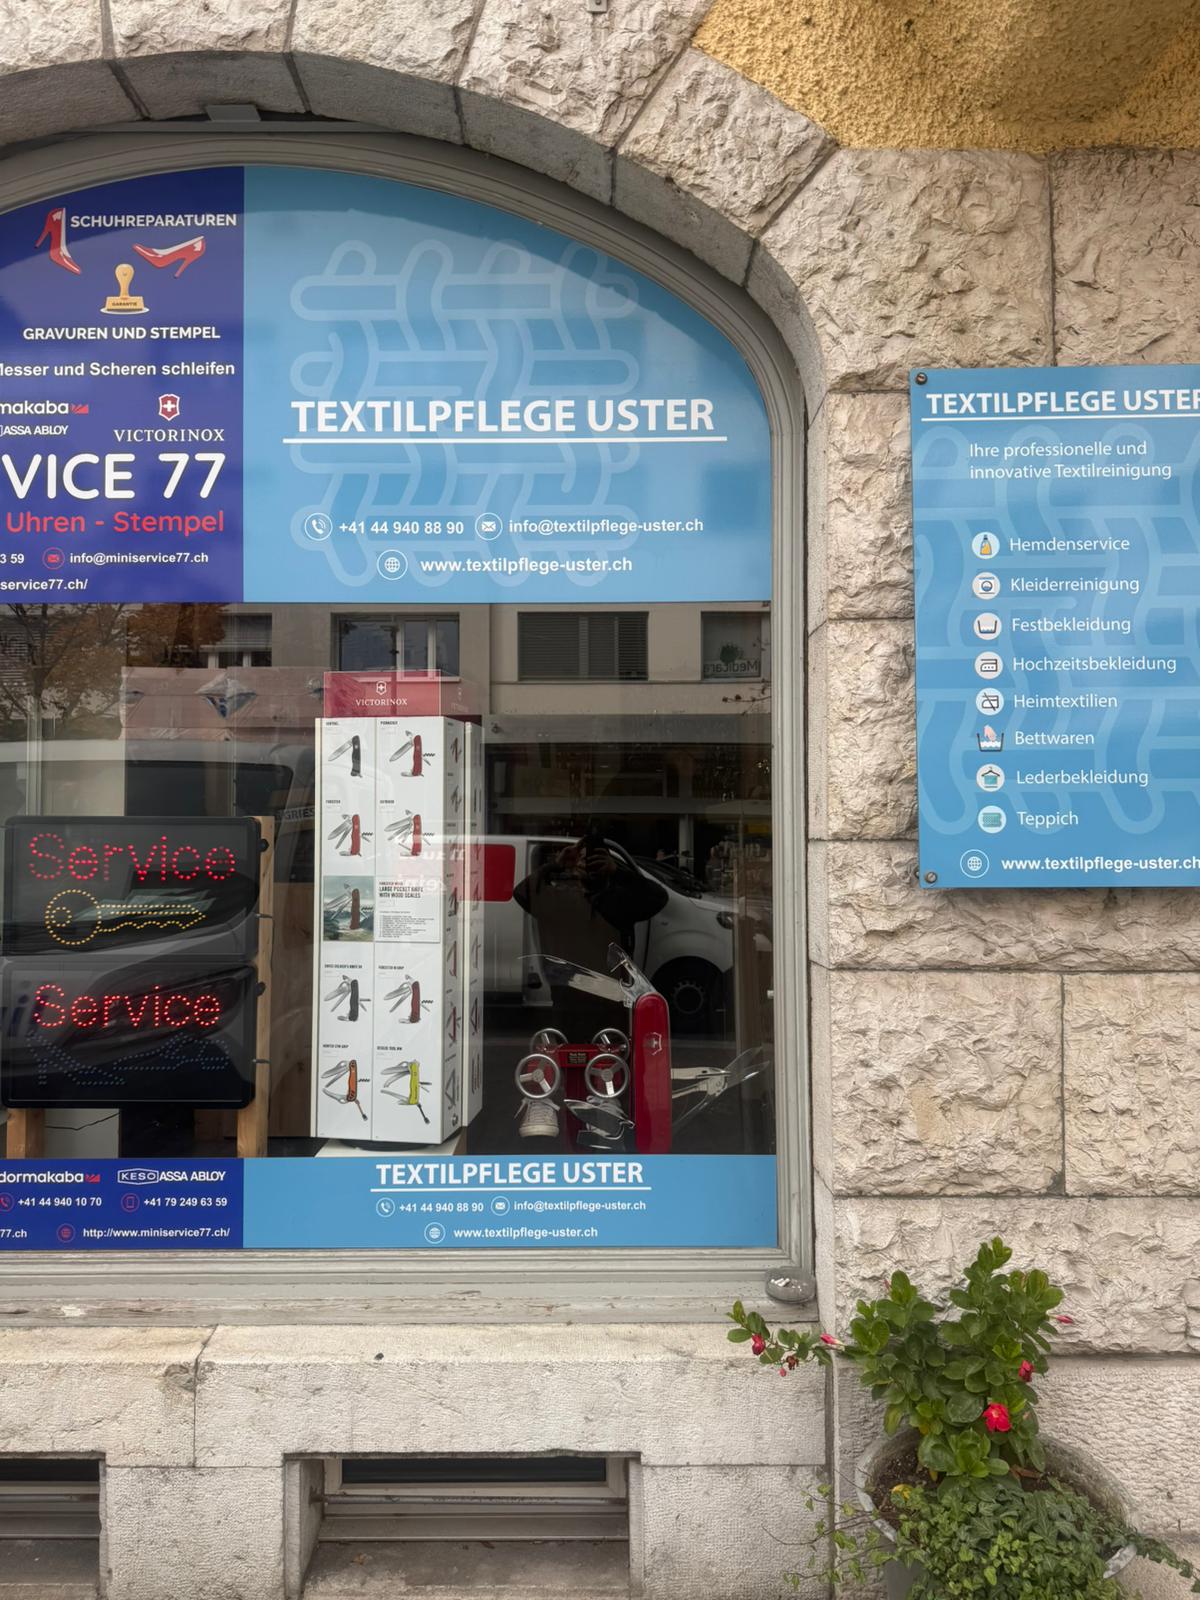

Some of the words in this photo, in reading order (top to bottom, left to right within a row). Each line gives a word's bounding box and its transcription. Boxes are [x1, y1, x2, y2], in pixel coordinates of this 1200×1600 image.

[70, 214, 237, 228] SCHUHREPARATUREN
[23, 328, 108, 340] GRAVUREN
[112, 328, 146, 340] UND
[150, 327, 220, 339] STEMPEL
[0, 363, 49, 376] esser
[54, 363, 84, 376] und
[89, 363, 156, 376] Scheren
[161, 362, 235, 375] schleifen
[926, 391, 1116, 414] TEXTILPFLEGE
[291, 400, 576, 432] TEXTILPFLEGE
[588, 399, 714, 431] USTER
[4, 425, 31, 435] ASSA
[34, 425, 68, 435] ABLOY
[114, 429, 224, 442] VICTORINOX
[970, 443, 999, 457] Ihre
[1003, 441, 1112, 459] professionelle
[1116, 441, 1147, 455] und
[2, 454, 135, 499] VICE
[158, 453, 226, 498] 77
[970, 465, 1051, 480] innovative
[1054, 463, 1172, 480] Textilreinigung
[7, 512, 85, 533] Uhren
[113, 511, 224, 537] Stempel
[339, 521, 365, 535] +41
[370, 521, 389, 535] 44
[393, 521, 420, 535] 940
[425, 520, 443, 535] 88
[446, 520, 465, 534] 90
[509, 518, 704, 536] info@textilpflege-uster.ch
[1009, 537, 1130, 552] Hemdenservice
[10, 554, 25, 564] 59
[70, 553, 208, 566] info@miniservice77.ch
[420, 557, 633, 575] www.textilpflege-uster.ch
[1010, 577, 1140, 594] Kleiderreinigung
[1012, 616, 1132, 633] Festbekleidung
[1013, 656, 1177, 673] Hochzeitsbekleidung
[1014, 694, 1118, 709] Heimtextilien
[1015, 731, 1095, 745] Bettwaren
[1016, 770, 1149, 788] Lederbekleidung
[1017, 810, 1079, 827] Teppich
[29, 833, 235, 880] Service
[1001, 855, 1200, 873] www.textilpflege-uster.ch
[33, 983, 221, 1028] Service
[0, 1171, 83, 1183] dormakaba
[122, 1172, 157, 1181] KESO
[160, 1171, 188, 1181] ASSA
[191, 1171, 226, 1181] ABLOY
[376, 1163, 556, 1184] TEXTILPFLEGE
[563, 1162, 643, 1183] USTER
[18, 1198, 35, 1206] +41
[39, 1198, 51, 1206] 44
[54, 1198, 72, 1206] 940
[76, 1198, 87, 1206] 10
[90, 1198, 102, 1206] 70
[144, 1198, 161, 1206] +41
[165, 1198, 176, 1206] 79
[180, 1198, 197, 1206] 249
[201, 1198, 212, 1206] 63
[216, 1198, 228, 1206] 59
[399, 1203, 417, 1212] +41
[421, 1203, 433, 1212] 44
[436, 1203, 454, 1212] 940
[457, 1203, 469, 1212] 88
[472, 1203, 484, 1212] 90
[514, 1200, 646, 1212] info@textilpflege-uster.ch
[0, 1229, 27, 1238] 77.ch
[83, 1228, 230, 1238] http://www.miniservice77.ch/
[453, 1227, 598, 1240] www.textilpflege-uster.ch
